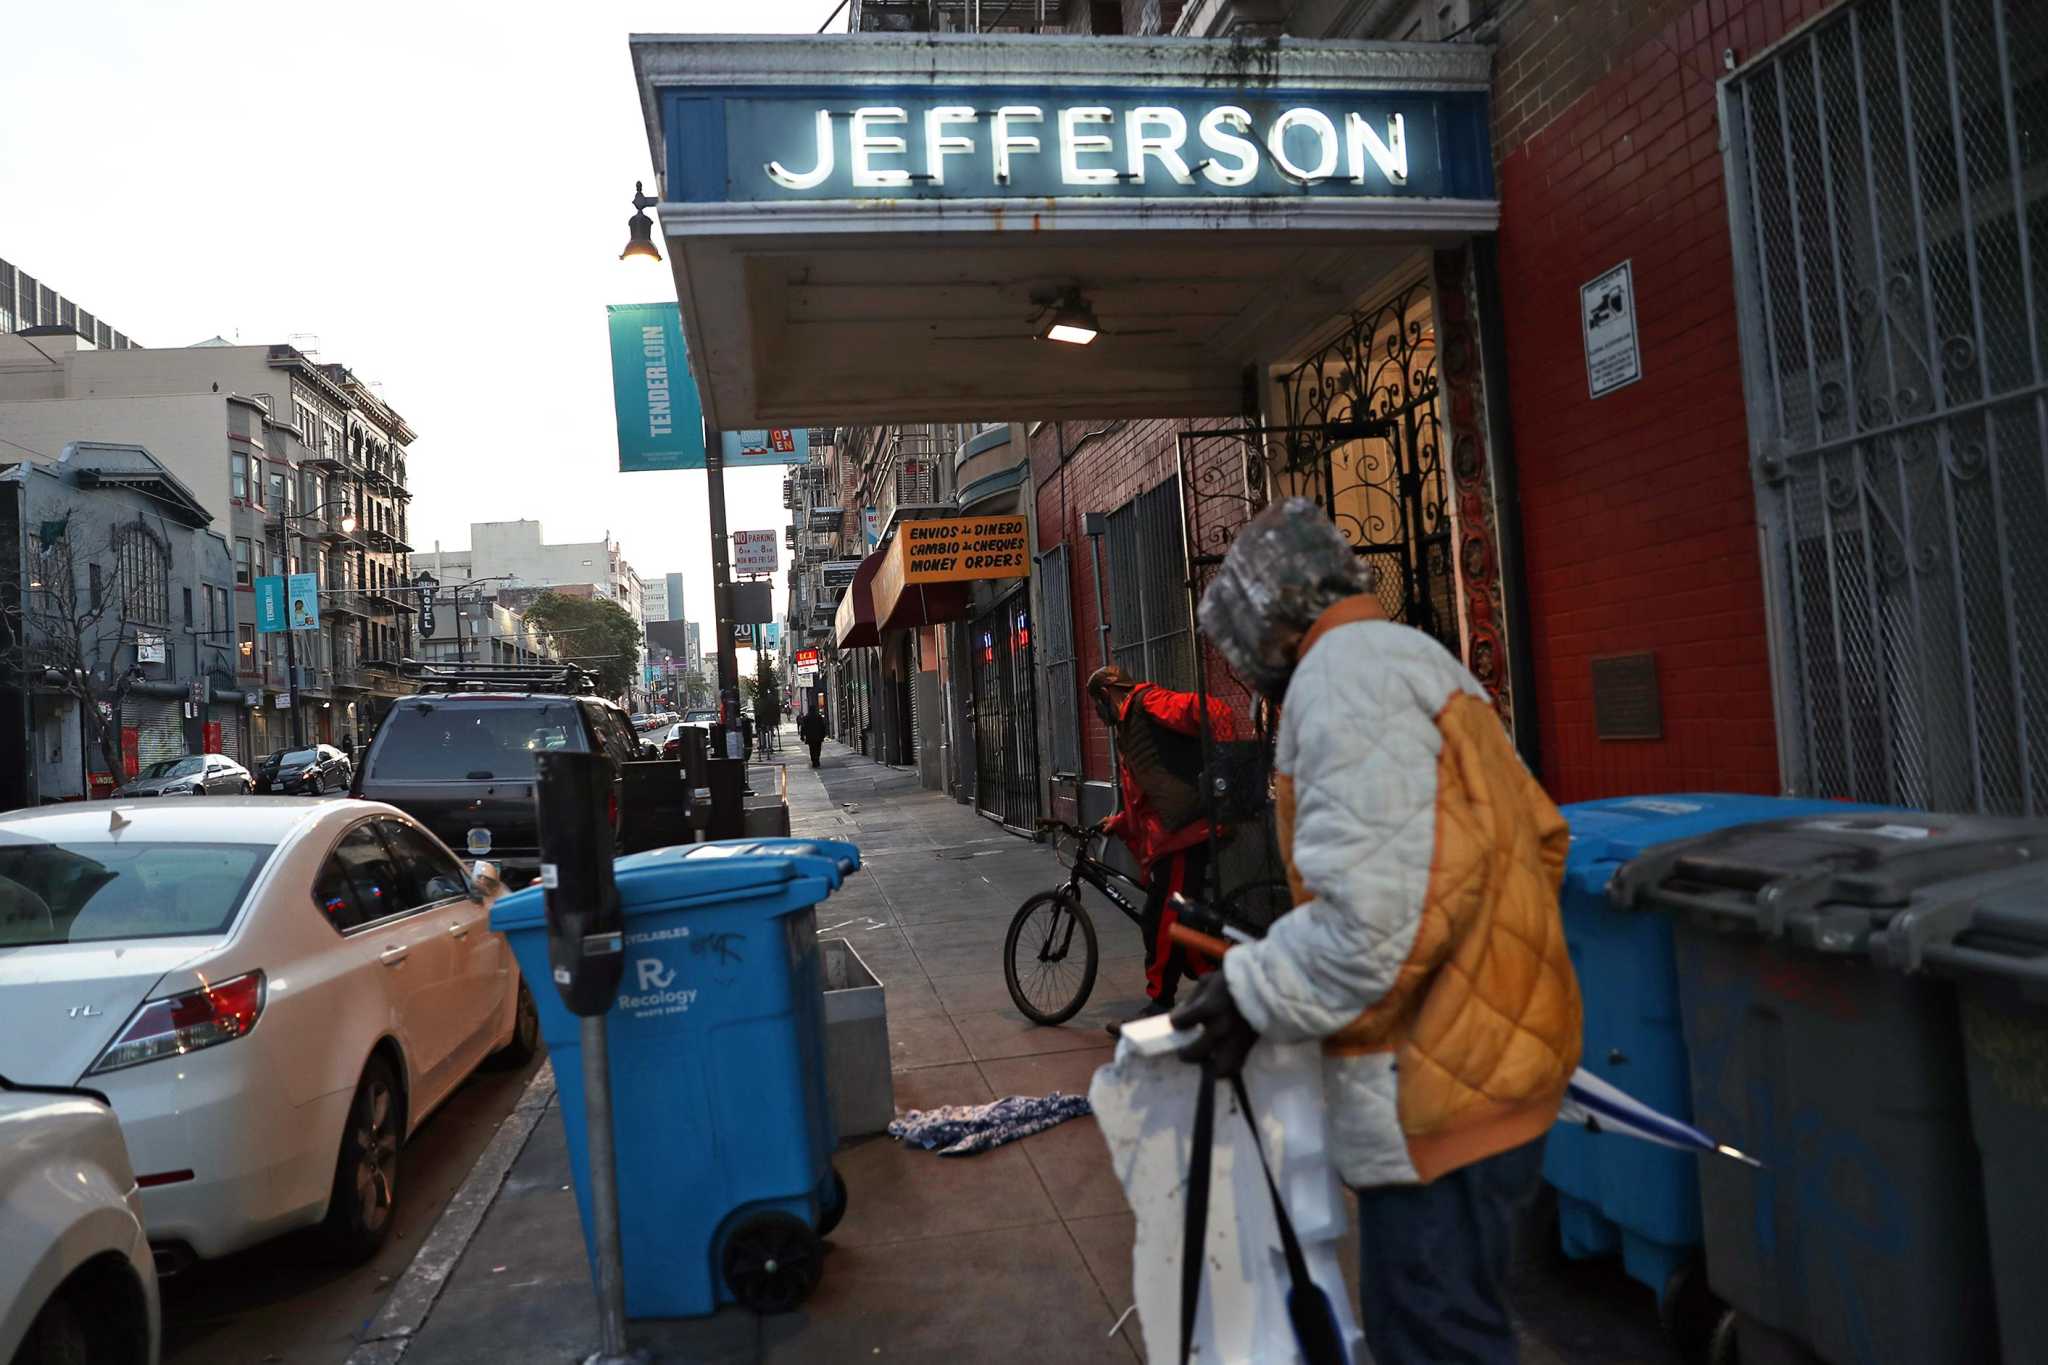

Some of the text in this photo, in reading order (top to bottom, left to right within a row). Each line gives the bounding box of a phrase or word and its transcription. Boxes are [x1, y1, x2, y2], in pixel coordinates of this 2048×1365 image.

[764, 106, 1408, 190] JEFFERSON
[642, 326, 672, 437] TENDERLOIN
[735, 532, 775, 544] NO PARKING
[910, 526, 959, 539] ENVIOS
[974, 522, 1022, 536] DINERO
[910, 543, 960, 556] CAMBIO
[973, 537, 1025, 552] CHEQUES
[911, 554, 1023, 572] MONEY ORDERS
[423, 589, 432, 629] HOTEL
[625, 927, 690, 944] YCLABLES
[618, 989, 697, 1010] Recology
[67, 1005, 103, 1017] TL
